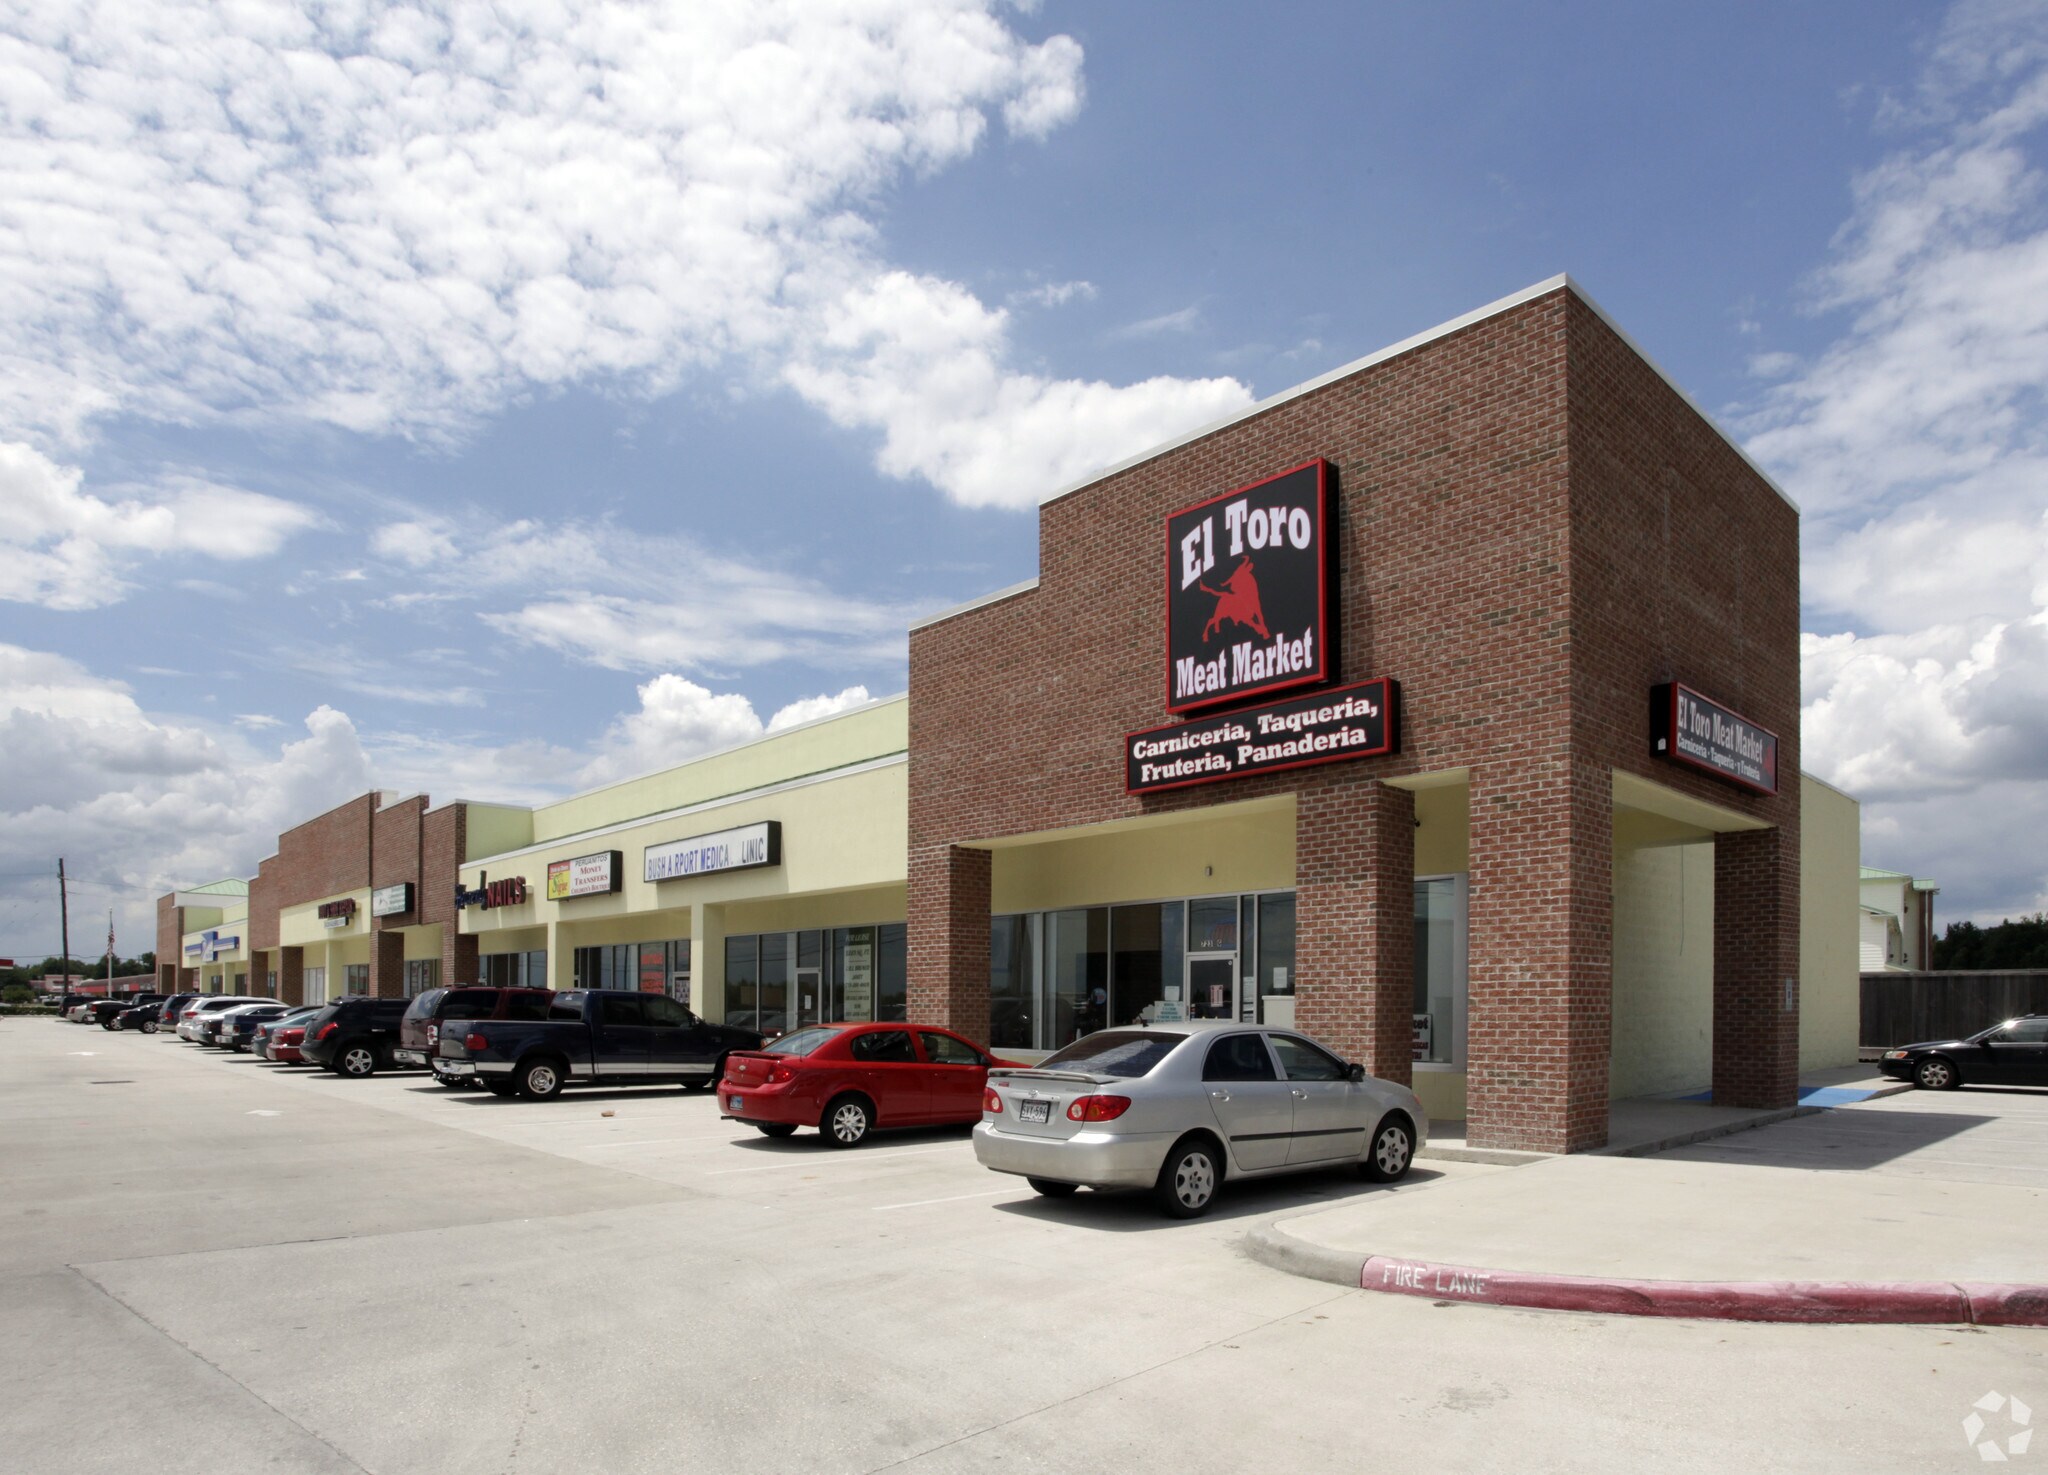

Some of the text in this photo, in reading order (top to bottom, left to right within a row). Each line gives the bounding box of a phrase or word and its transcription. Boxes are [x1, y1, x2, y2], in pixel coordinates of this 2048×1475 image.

[1181, 498, 1311, 591] El Toro
[1176, 625, 1312, 698] Meat Market
[1133, 697, 1379, 759] Carniceria, Taqueria,
[1141, 726, 1366, 783] Fruteria, Panaderia
[1678, 695, 1763, 764] El Toro Meat Market
[487, 875, 527, 908] NAILS
[648, 856, 666, 879] BUSH
[1382, 1264, 1490, 1296] FIRE LANE
